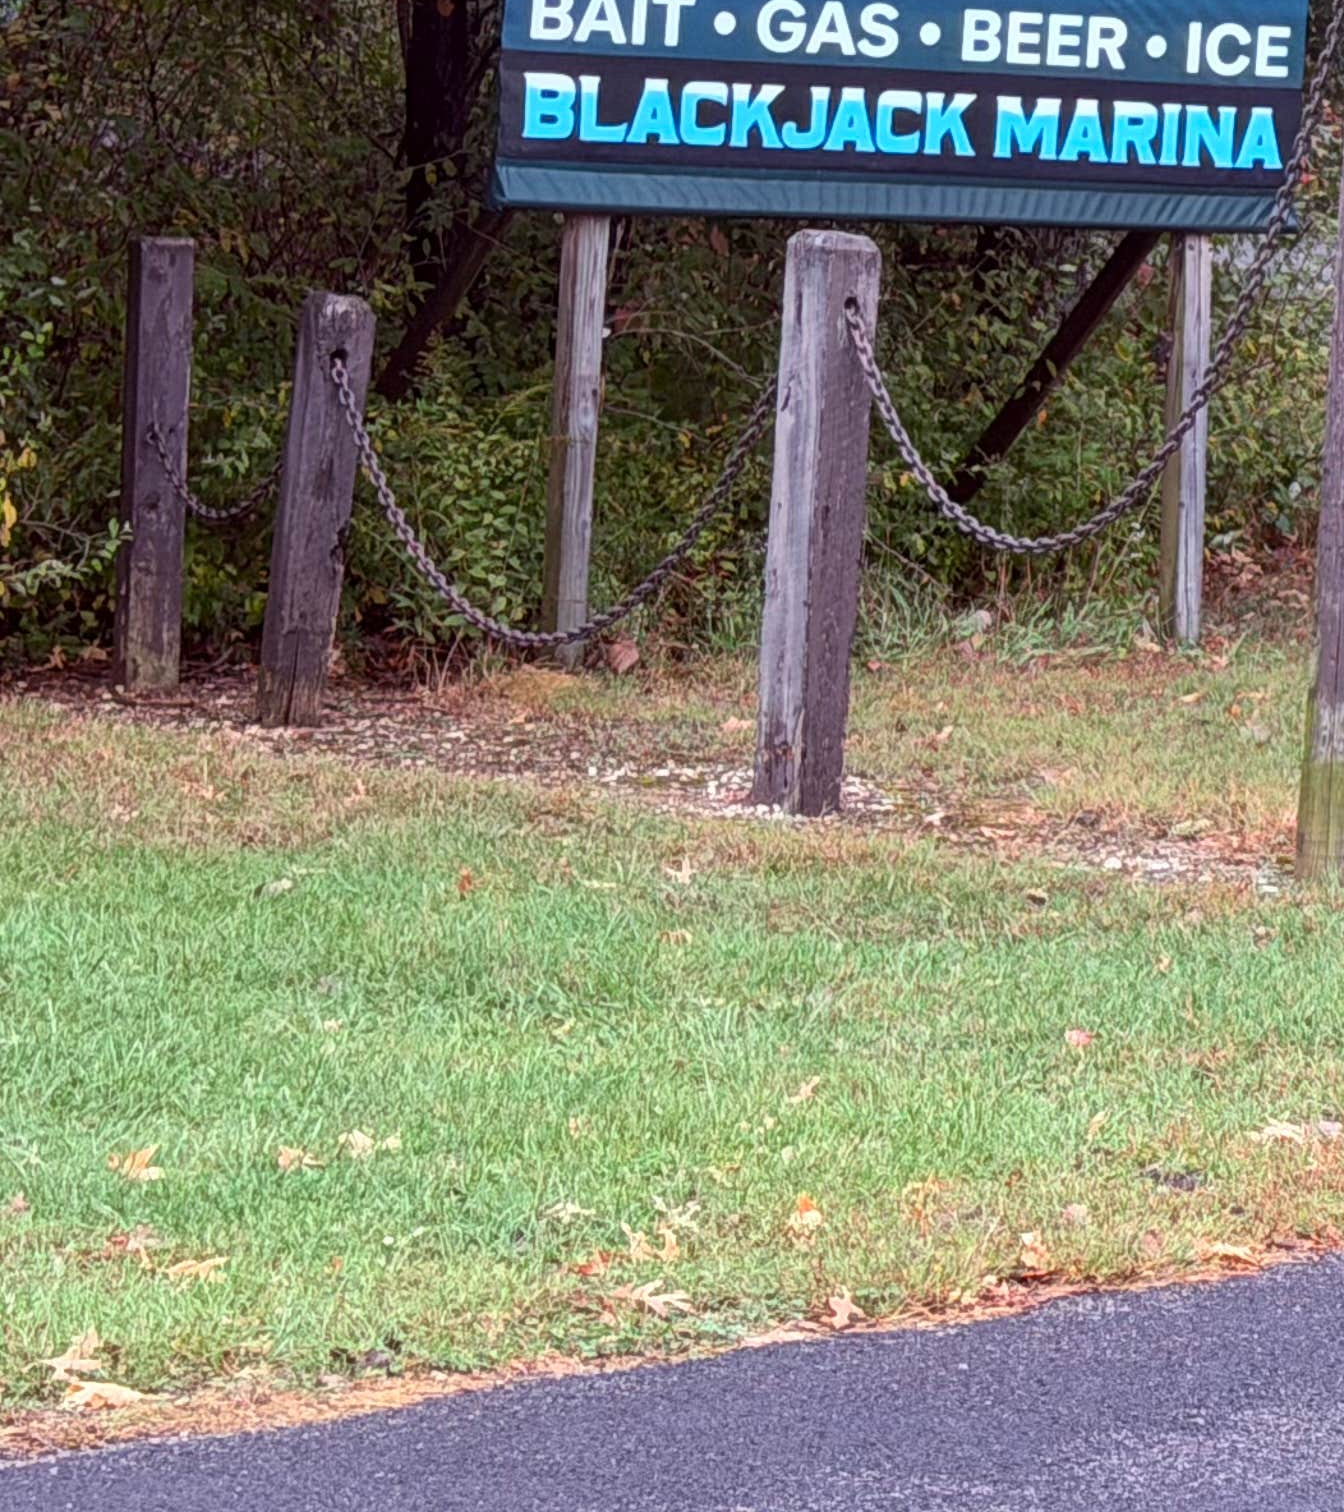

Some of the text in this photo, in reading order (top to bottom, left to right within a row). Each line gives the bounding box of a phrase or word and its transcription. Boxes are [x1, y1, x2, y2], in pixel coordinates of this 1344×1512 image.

[960, 9, 1127, 70] BEER
[1185, 23, 1291, 79] ICE
[520, 71, 1283, 170] BLACKJACK MARINA
